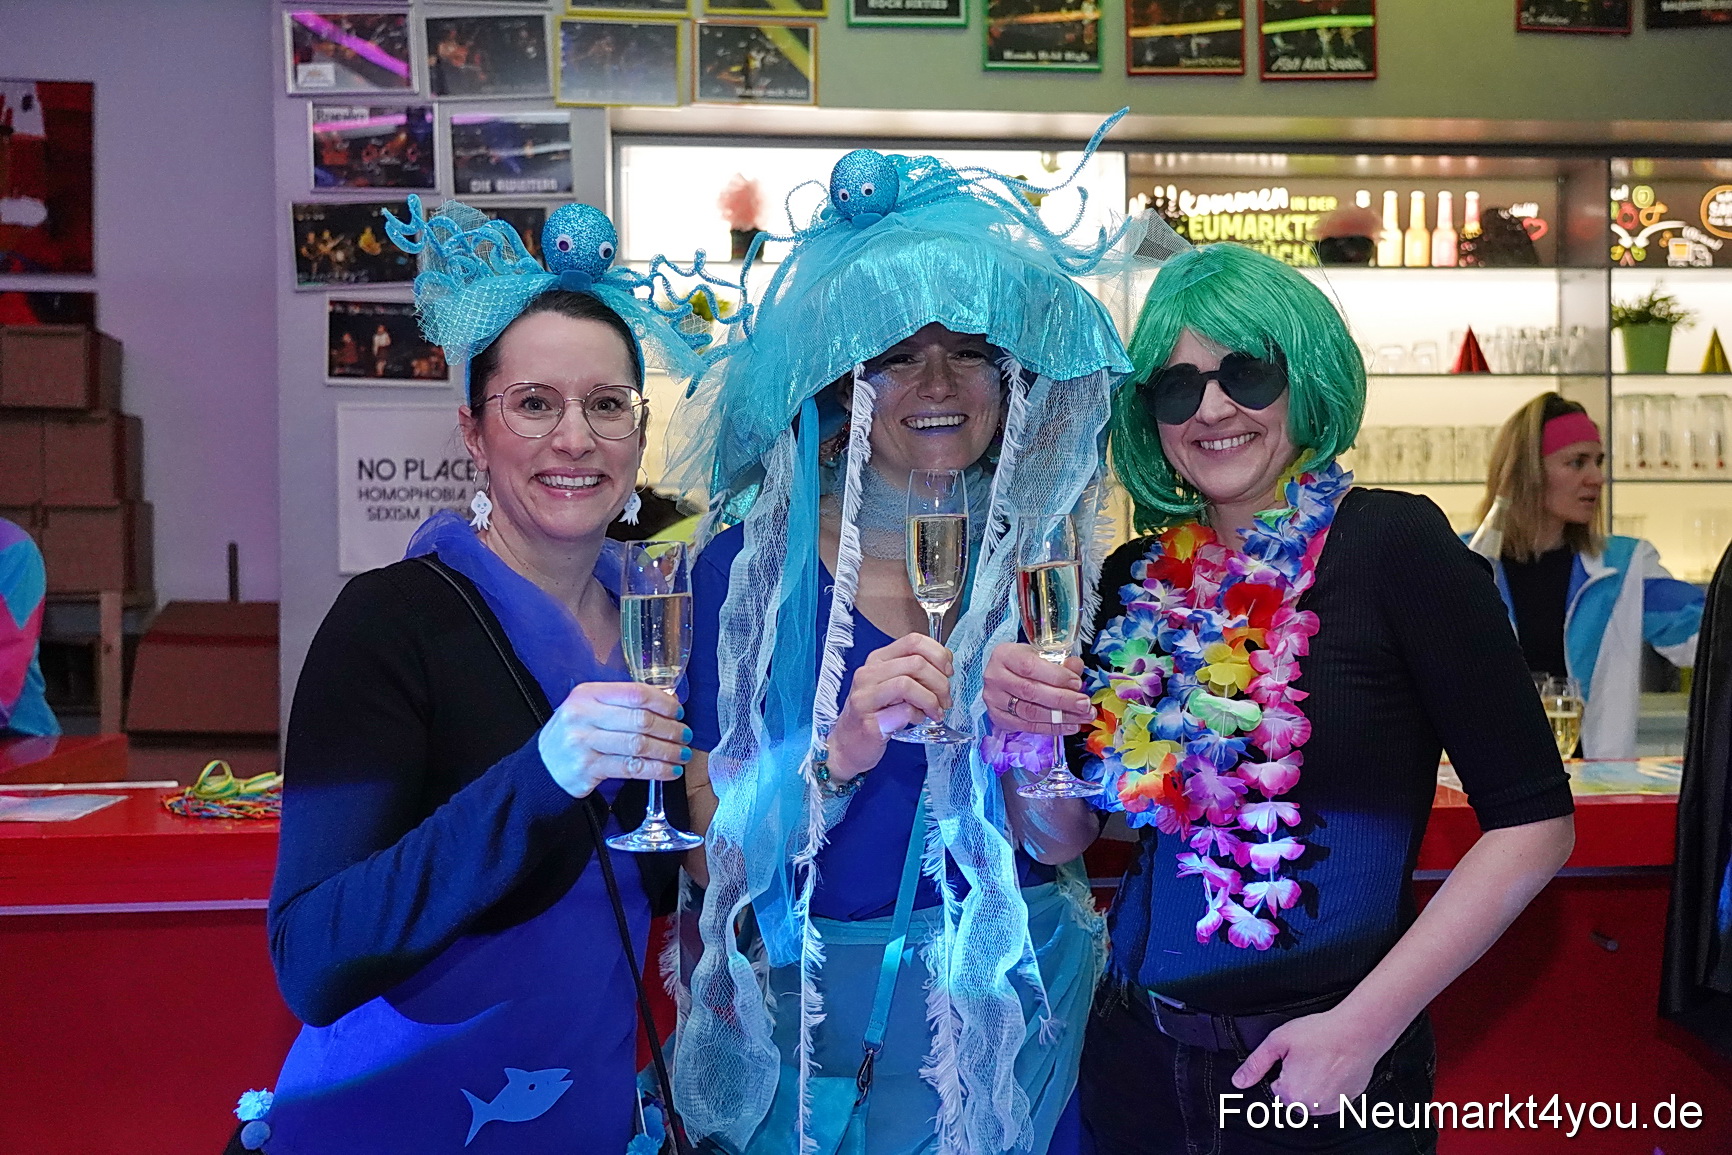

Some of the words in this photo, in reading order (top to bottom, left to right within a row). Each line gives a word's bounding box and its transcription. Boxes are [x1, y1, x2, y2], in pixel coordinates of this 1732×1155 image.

[1308, 196, 1338, 211] DER
[1178, 213, 1321, 241] EUMARKTE
[358, 458, 397, 481] NO
[404, 458, 475, 481] PLACE
[358, 487, 467, 501] HOMOPHOBIA
[367, 505, 421, 521] SEXISM
